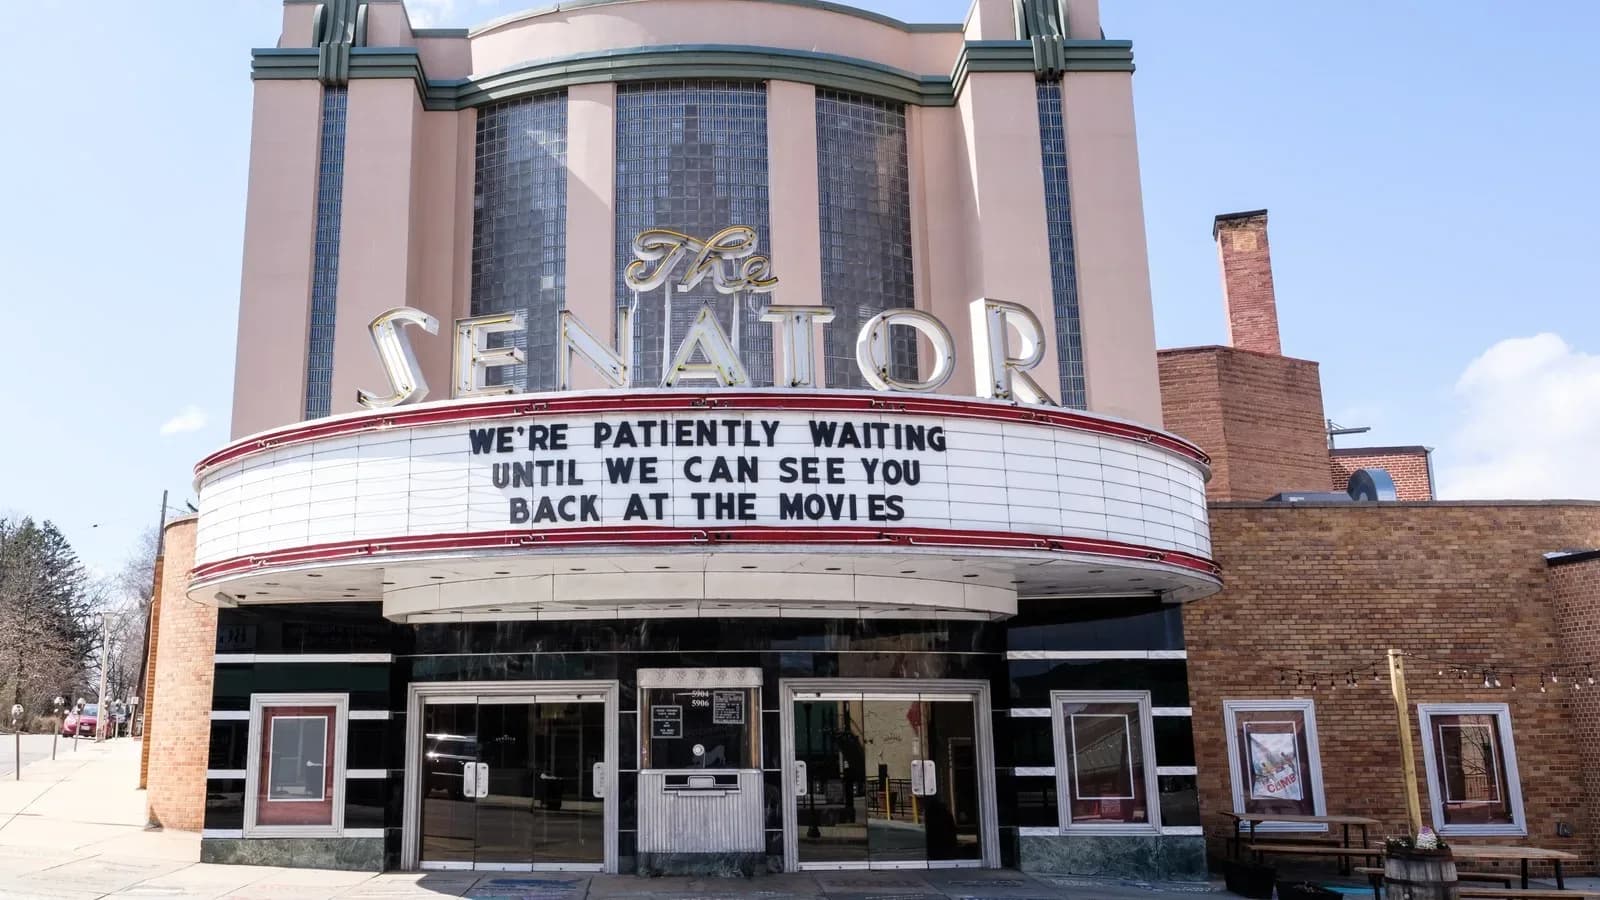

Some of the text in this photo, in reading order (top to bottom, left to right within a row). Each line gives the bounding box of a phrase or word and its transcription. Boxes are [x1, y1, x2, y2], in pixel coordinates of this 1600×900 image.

[624, 225, 778, 293] The
[357, 297, 1062, 409] SENATOR
[469, 419, 947, 455] WE'RE PATIENTLY WAITING
[492, 455, 921, 489] UNTIL WE CAN SEE YOU
[510, 492, 905, 524] BACK AT THE MOVIES
[691, 699, 709, 707] 5906
